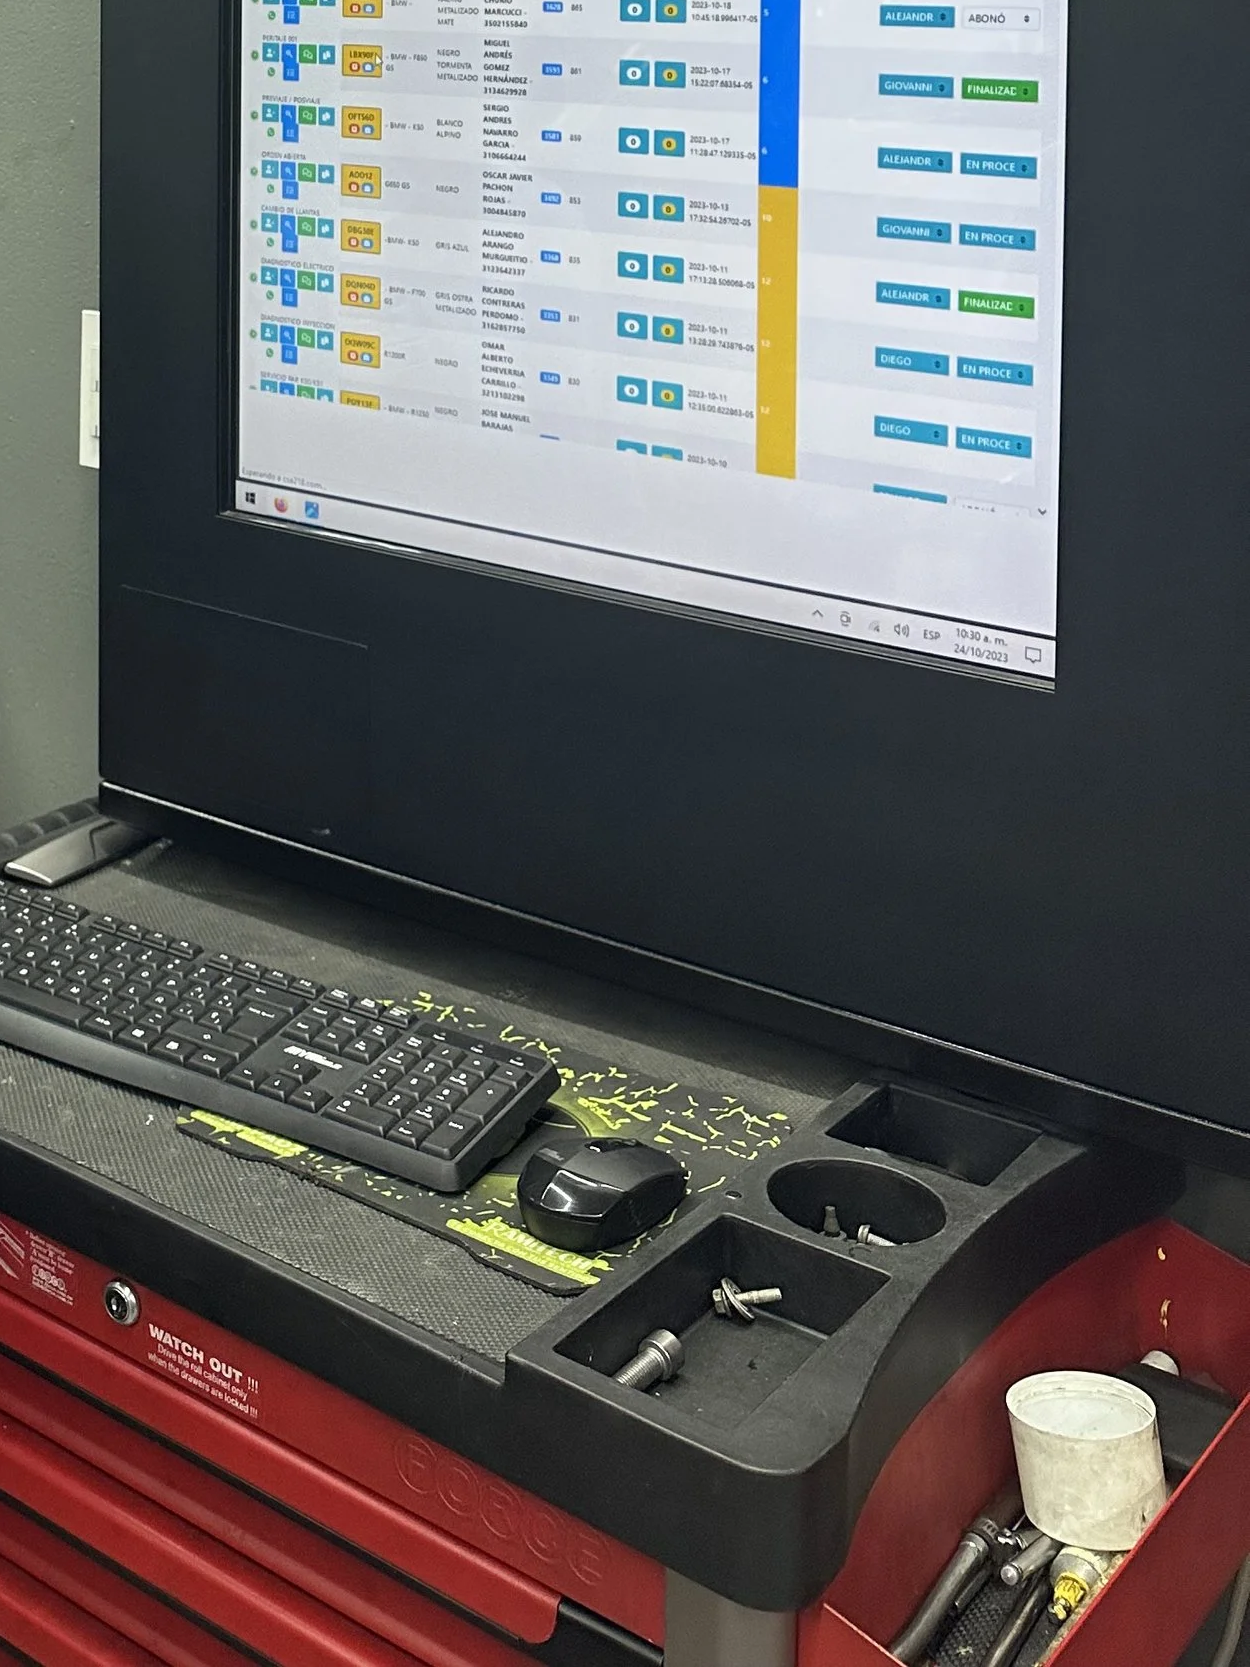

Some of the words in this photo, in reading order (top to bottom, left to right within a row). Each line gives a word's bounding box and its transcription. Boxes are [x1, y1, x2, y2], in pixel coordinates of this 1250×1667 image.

[885, 12, 934, 22] ALEJANDR
[968, 11, 1006, 24] ABONÓ
[884, 81, 932, 92] GIOVANNI
[883, 155, 931, 166] ALEJANDR
[967, 160, 979, 169] EN
[983, 161, 1016, 172] PROCE
[883, 223, 930, 237] GIOVANNI
[965, 231, 979, 241] EN
[981, 232, 1014, 245] PROCE
[881, 288, 929, 302] ALEJANDR
[881, 354, 911, 367] DIEGO
[963, 364, 976, 375] EN
[979, 366, 1011, 379] PROCE
[880, 422, 911, 435] DIEGO
[962, 434, 975, 445] EN
[977, 436, 1010, 450] PROCE
[923, 629, 941, 640] ESP
[956, 628, 981, 642] 10:30
[954, 644, 1009, 663] 24/10/2023
[149, 1323, 204, 1364] WATCH
[209, 1357, 242, 1383] OUT
[157, 1343, 176, 1361] Drive
[178, 1354, 189, 1369] the
[203, 1371, 230, 1391] cabinet
[231, 1385, 247, 1402] only
[148, 1352, 167, 1369] when
[168, 1361, 180, 1376] the
[181, 1370, 210, 1392] drawers
[211, 1388, 223, 1400] are
[224, 1392, 248, 1414] locked
